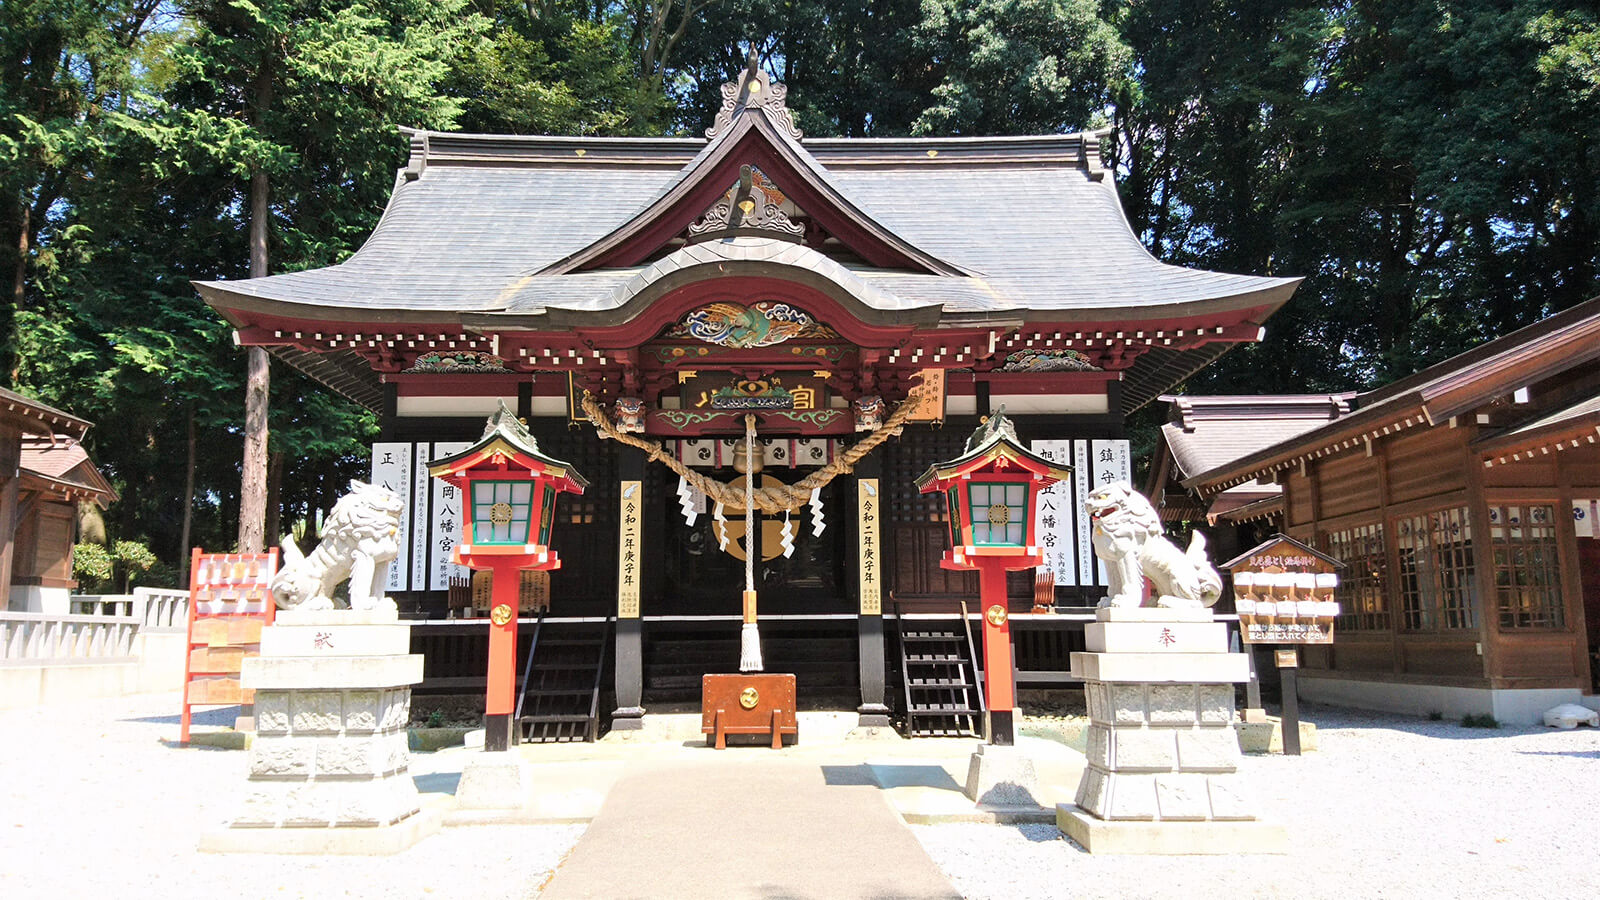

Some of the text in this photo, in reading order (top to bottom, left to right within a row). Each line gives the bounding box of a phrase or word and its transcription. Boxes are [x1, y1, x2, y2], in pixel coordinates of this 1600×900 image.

[439, 451, 455, 552] 岡八幡宮
[623, 502, 636, 586] 令和二年庚子年
[863, 500, 875, 584] 令和二年庚子年
[1057, 552, 1067, 583] 家内安全
[440, 557, 448, 587] 必勝祈願
[1158, 627, 1176, 648] 奉
